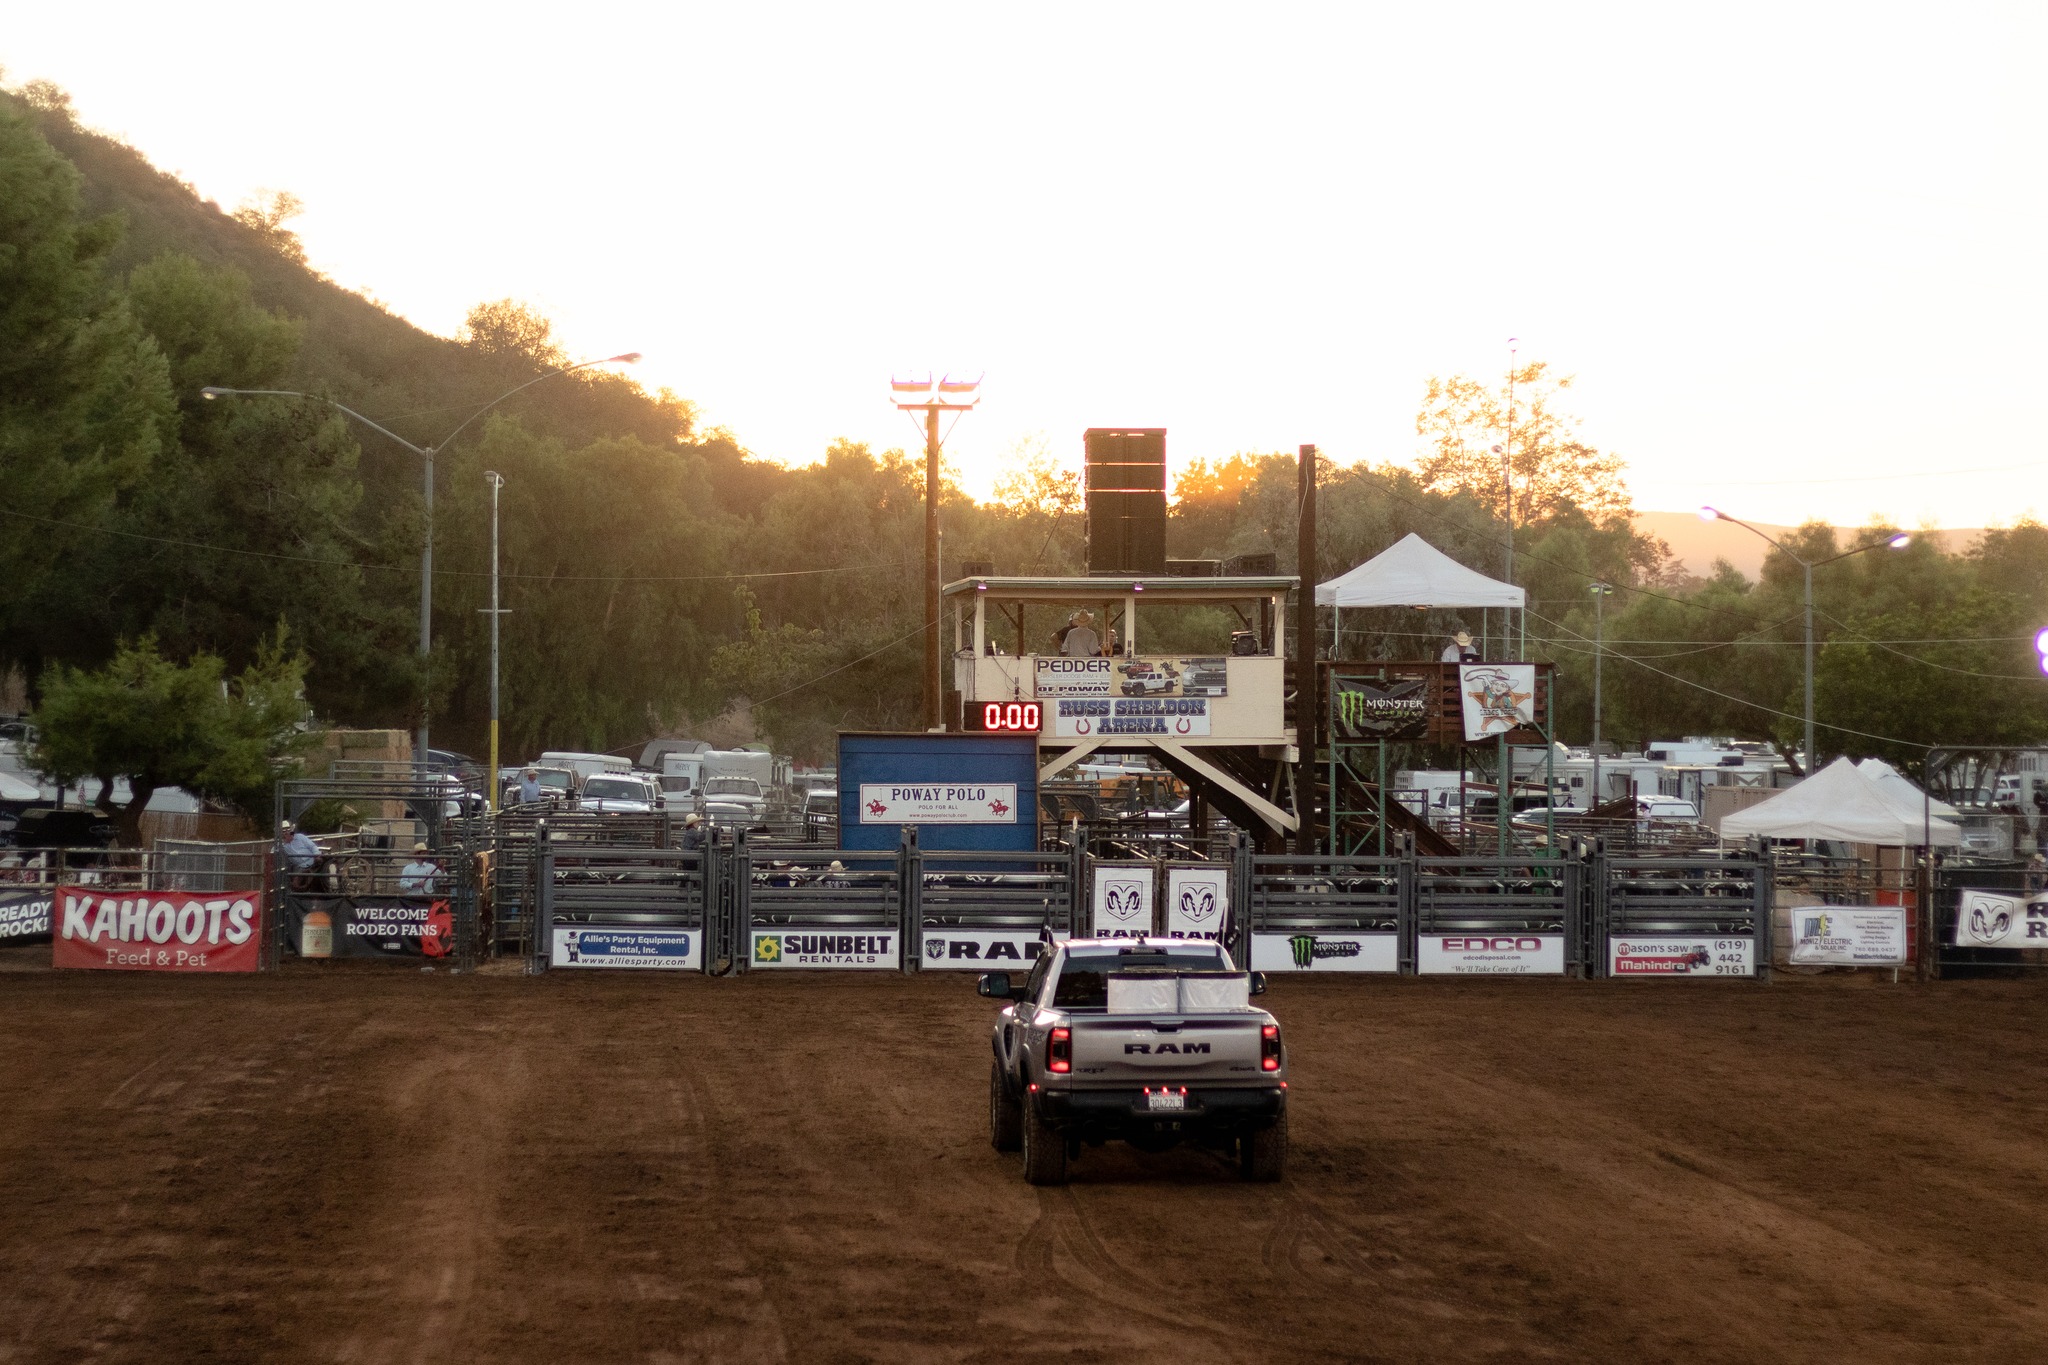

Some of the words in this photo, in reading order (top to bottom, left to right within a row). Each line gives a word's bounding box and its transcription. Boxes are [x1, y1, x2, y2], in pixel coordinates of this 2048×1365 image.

[1037, 660, 1111, 673] PEDDER
[1059, 699, 1111, 717] RUSS
[1115, 699, 1206, 717] SHELDON
[1366, 698, 1425, 709] MONSTER
[985, 704, 1039, 729] 0.00
[1097, 717, 1169, 735] ARENA
[891, 788, 941, 801] POWAY
[946, 788, 986, 801] POLO
[0, 901, 51, 922] READY
[355, 908, 429, 920] WELCOME
[62, 895, 253, 945] KAHOOTS
[0, 917, 48, 938] ROCK!
[346, 923, 398, 936] RODEO
[401, 924, 437, 936] FANS
[1096, 929, 1150, 938] RAM
[583, 935, 611, 943] Allie's
[612, 935, 636, 945] Party
[637, 936, 686, 945] Equipment
[784, 935, 892, 954] SUNBELT
[1442, 937, 1542, 953] EDCO
[1714, 940, 1747, 951] (619)
[1823, 938, 1853, 946] ELECTRIC
[610, 946, 641, 954] Rental,
[642, 946, 659, 954] Inc.
[1313, 943, 1358, 951] MONSTER
[1667, 945, 1689, 953] saw
[106, 948, 151, 965] Feed
[155, 951, 170, 966] &
[175, 951, 208, 966] Pet
[581, 957, 686, 966] www.alliesparty.com
[799, 955, 876, 963] RENTALS
[1718, 953, 1742, 963] 442
[1475, 965, 1491, 973] Take
[1492, 965, 1509, 973] Care
[1510, 965, 1519, 974] of
[1621, 961, 1686, 970] Mahindra
[1715, 965, 1746, 974] 9161
[1124, 1043, 1211, 1055] RAM
